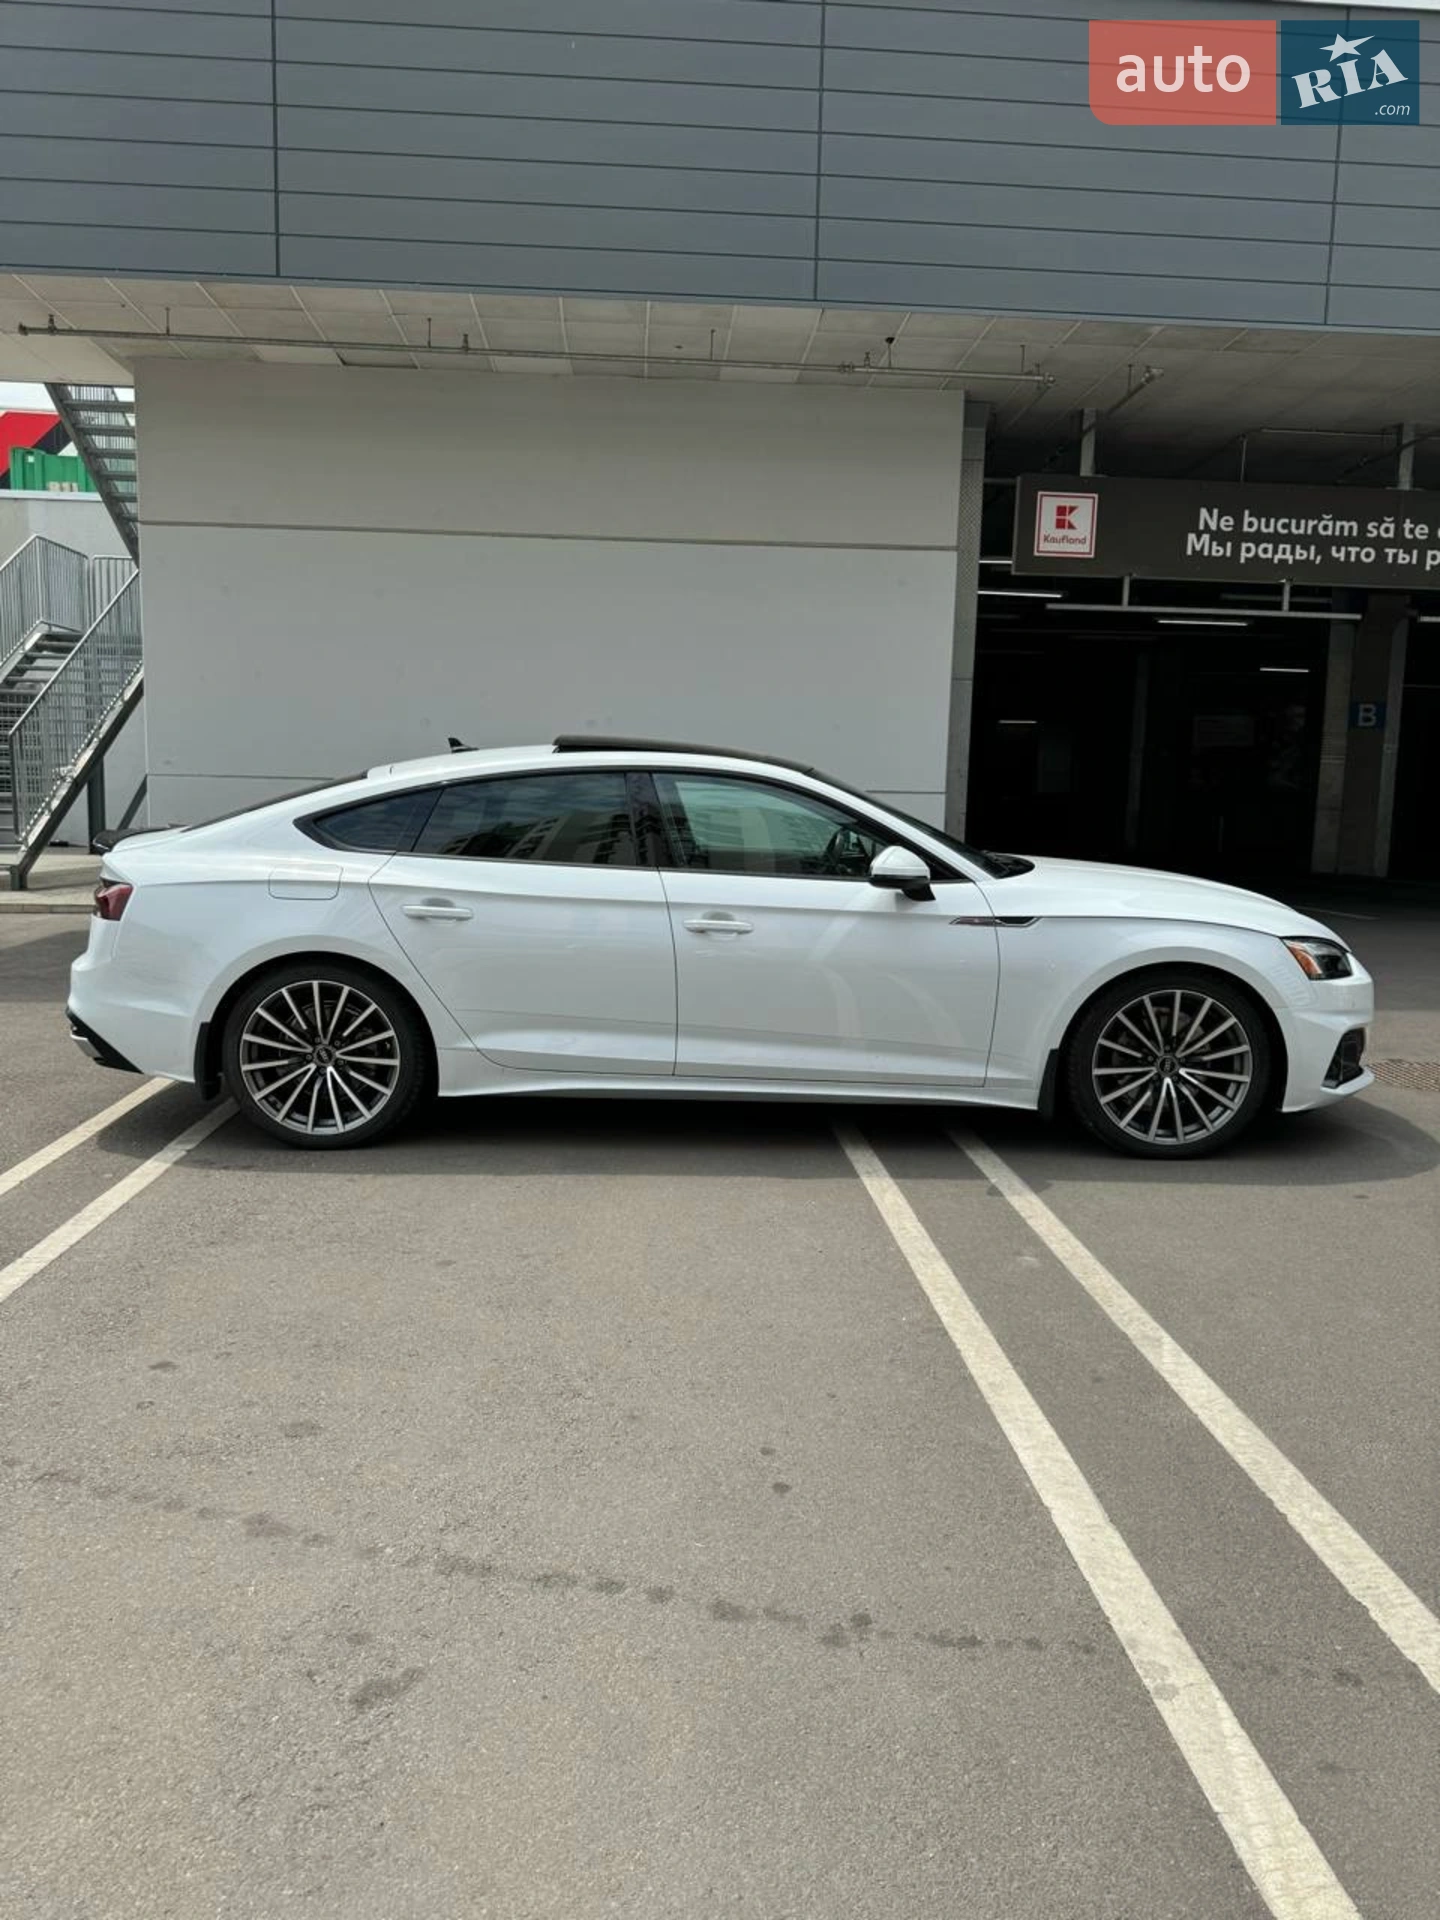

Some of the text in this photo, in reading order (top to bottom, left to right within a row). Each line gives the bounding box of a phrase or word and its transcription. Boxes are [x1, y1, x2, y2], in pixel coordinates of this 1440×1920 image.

[1055, 505, 1080, 530] K
[1198, 507, 1430, 540] Ne bucurăm să te
[1043, 533, 1087, 545] Kaufland
[1186, 532, 1233, 558] Мы
[1239, 541, 1322, 565] рады,
[1331, 545, 1376, 563] что
[1384, 547, 1418, 565] ты
[1358, 704, 1377, 727] B
